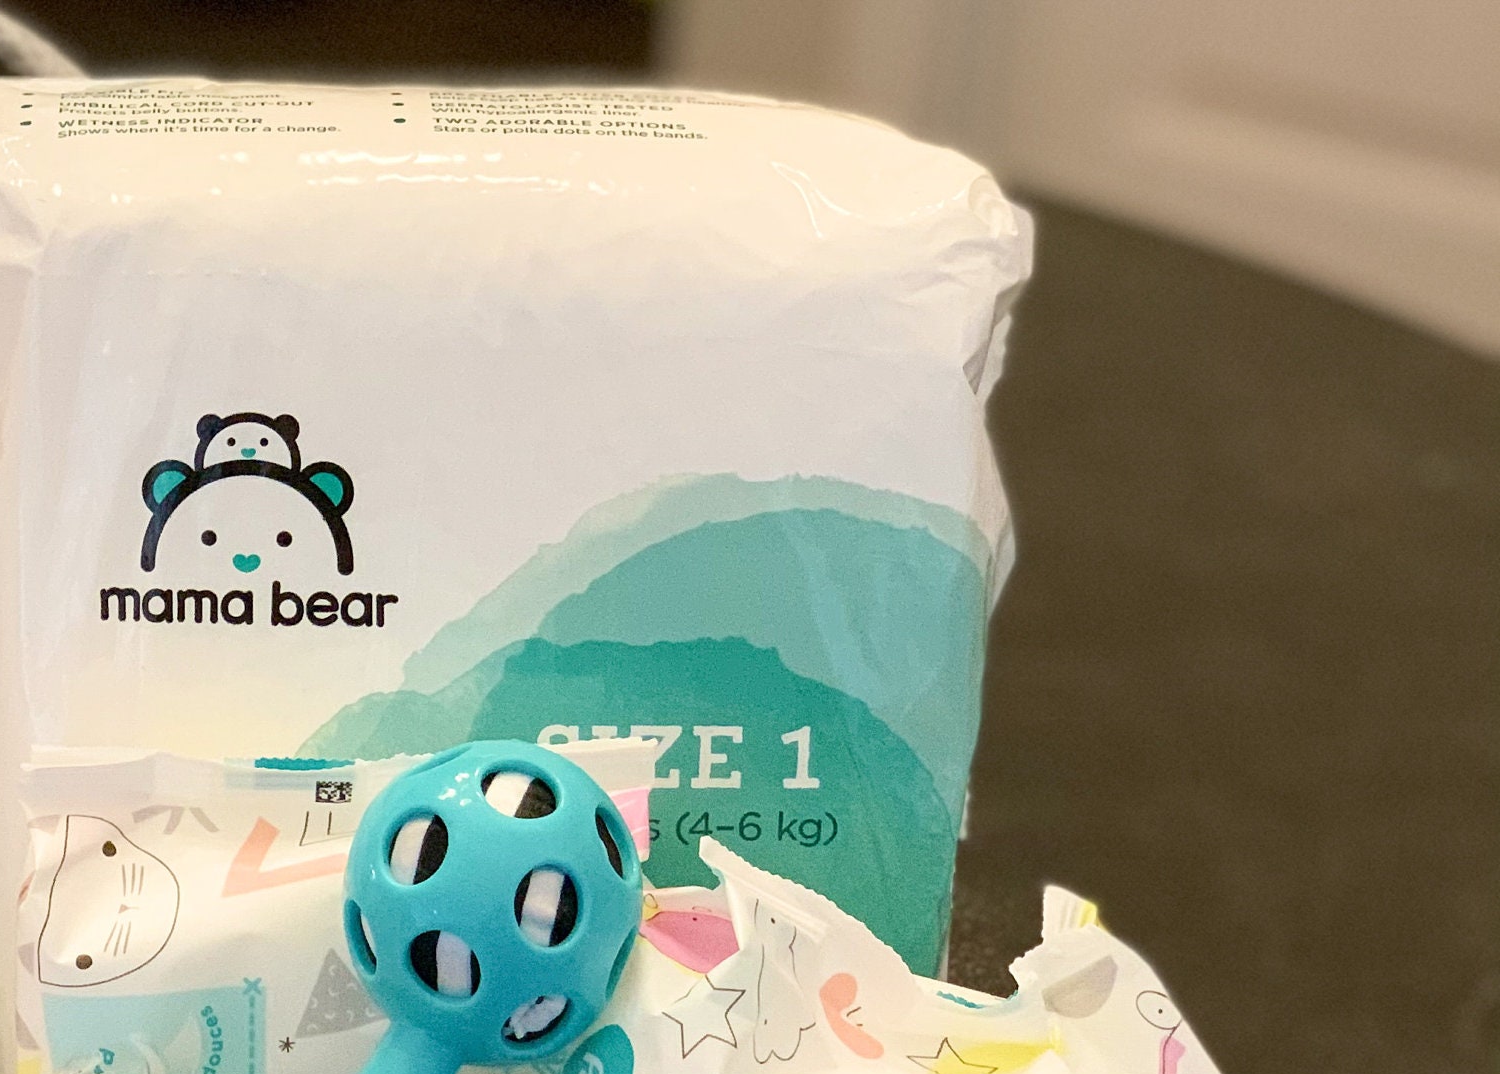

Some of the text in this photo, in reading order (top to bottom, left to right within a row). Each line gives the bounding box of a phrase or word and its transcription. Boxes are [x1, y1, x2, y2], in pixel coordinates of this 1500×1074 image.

[59, 101, 163, 109] UMBILICAL
[431, 102, 674, 112] DERMATOLOGIST TESTED
[58, 107, 127, 116] Protects
[476, 108, 598, 116] hypoallergenic
[58, 117, 264, 128] WETNESS INDICATOR
[486, 118, 592, 126] ADORABLE
[599, 120, 687, 130] OPTIONS
[57, 127, 110, 138] Shows
[115, 126, 159, 134] when
[164, 125, 187, 133] it's
[193, 125, 230, 133] time
[234, 125, 258, 133] for
[277, 125, 342, 133] change.
[433, 125, 476, 133] Stars
[502, 126, 549, 135] polka
[553, 127, 591, 135] dots
[621, 129, 648, 137] the
[653, 130, 709, 140] bands.
[99, 580, 399, 627] mama bear
[536, 723, 821, 789] ZE 1
[777, 811, 838, 848] kg)
